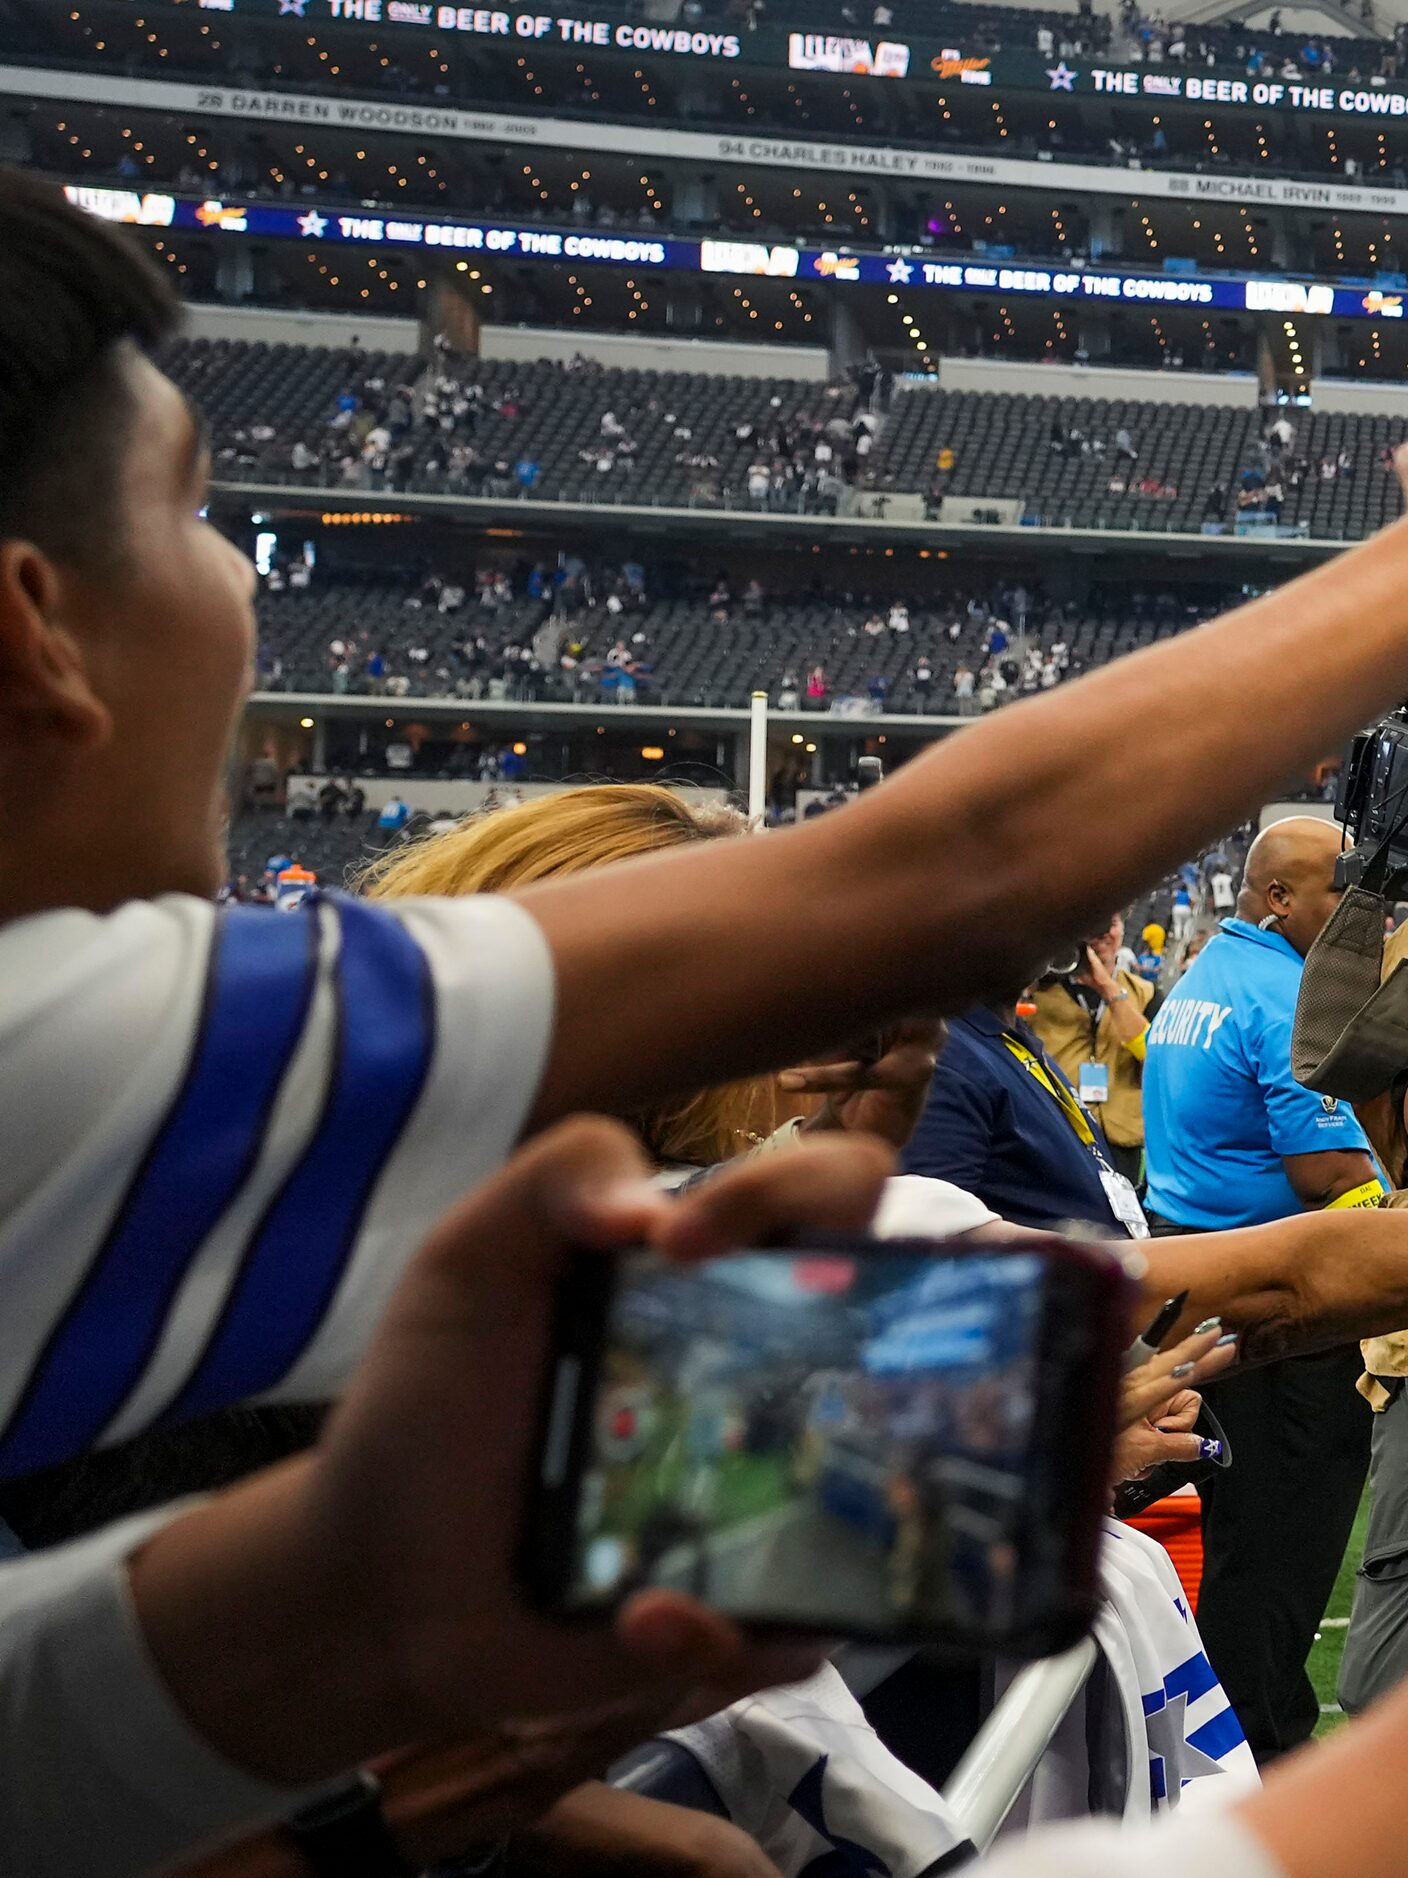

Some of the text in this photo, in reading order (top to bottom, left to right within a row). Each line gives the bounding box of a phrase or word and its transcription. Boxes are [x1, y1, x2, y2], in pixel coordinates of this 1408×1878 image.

[330, 0, 382, 21] THE
[438, 6, 510, 35] BEER
[516, 15, 552, 38] OF
[557, 19, 610, 45] THE
[615, 25, 741, 57] COWBOYS
[1091, 70, 1139, 94] THE
[1186, 78, 1248, 102] BEER
[1253, 83, 1284, 105] OF
[1288, 86, 1335, 109] THE
[231, 94, 329, 119] DARREN
[338, 106, 459, 130] WOODSON
[718, 140, 744, 155] 94
[749, 143, 845, 164] CHARLES
[850, 152, 920, 170] HALEY
[1195, 181, 1278, 199] MICHAEL
[1281, 187, 1332, 202] IRVIN
[338, 217, 385, 240] THE
[424, 224, 484, 249] BEER
[485, 230, 517, 250] OF
[518, 232, 562, 254] THE
[564, 235, 665, 263] COWBOYS
[922, 263, 963, 285] THE
[999, 269, 1051, 292] BEER
[1053, 273, 1080, 293] OF
[1081, 276, 1121, 296] THE
[1123, 278, 1213, 303] COWBOYS
